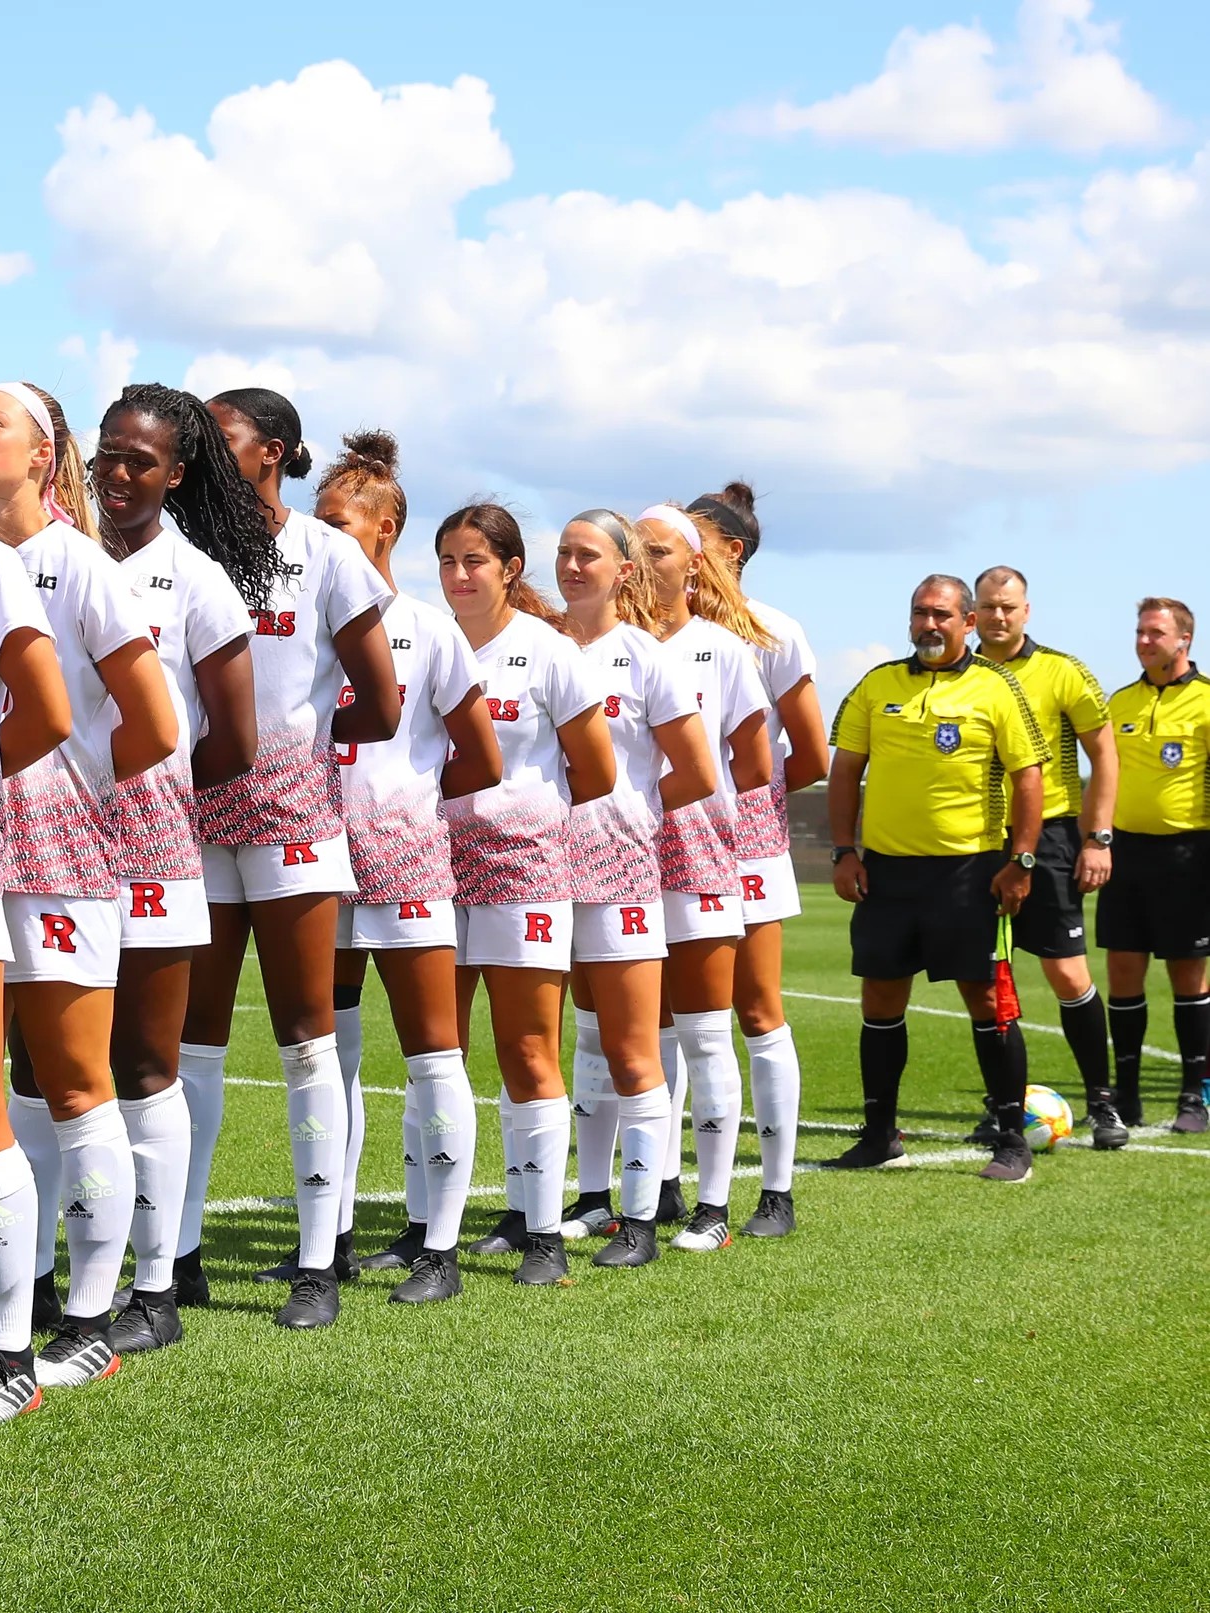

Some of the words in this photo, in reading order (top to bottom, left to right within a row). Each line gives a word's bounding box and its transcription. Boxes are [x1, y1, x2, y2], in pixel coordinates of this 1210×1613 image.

[130, 882, 167, 918] R
[741, 875, 766, 900] R
[40, 913, 76, 953] R
[524, 912, 552, 943] R
[621, 907, 649, 934] R
[303, 1180, 330, 1188] adidas
